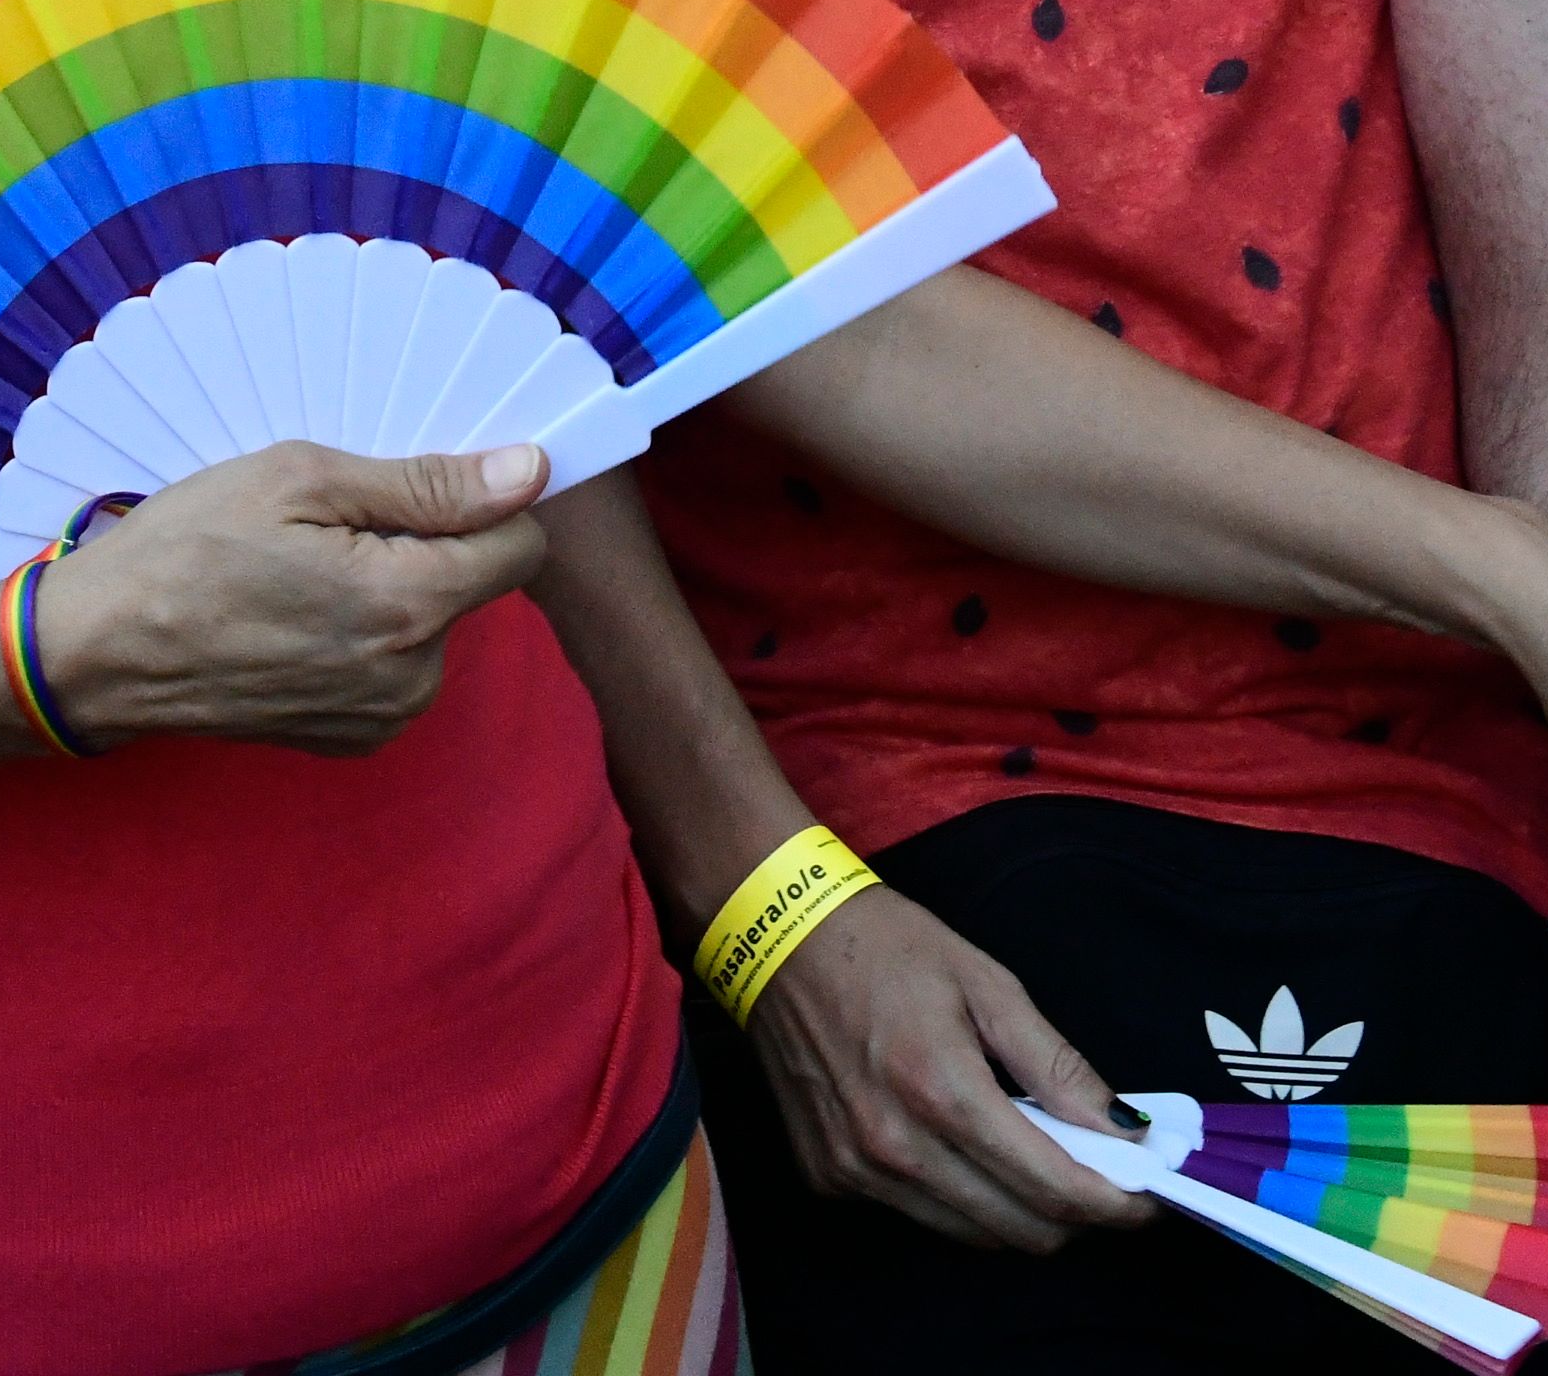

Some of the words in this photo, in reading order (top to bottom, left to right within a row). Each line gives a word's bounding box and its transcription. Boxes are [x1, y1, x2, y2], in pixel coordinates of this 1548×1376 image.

[712, 863, 827, 996] Pasajera/o/e
[764, 920, 799, 959] derechos
[804, 881, 843, 914] nuestras
